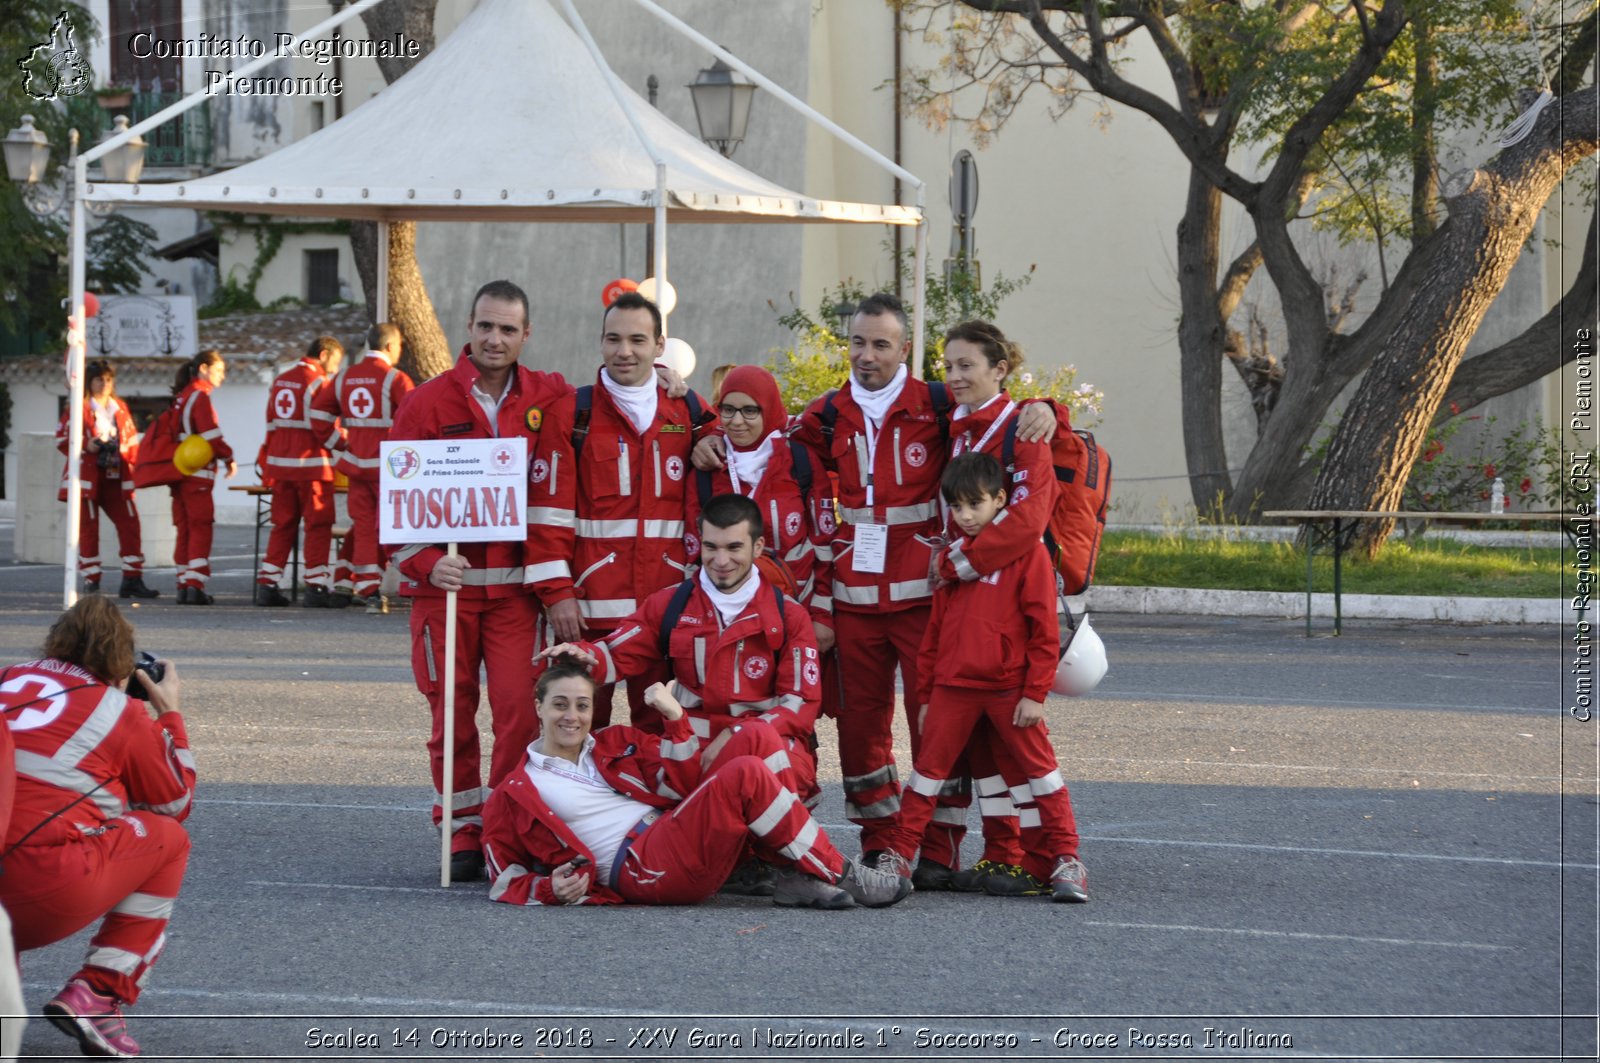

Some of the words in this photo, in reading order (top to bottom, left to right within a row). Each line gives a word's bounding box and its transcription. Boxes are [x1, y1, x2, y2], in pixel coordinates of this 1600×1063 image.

[445, 457, 480, 465] Nazionale
[452, 469, 484, 477] Soccorso
[388, 486, 520, 530] TOSCANA
